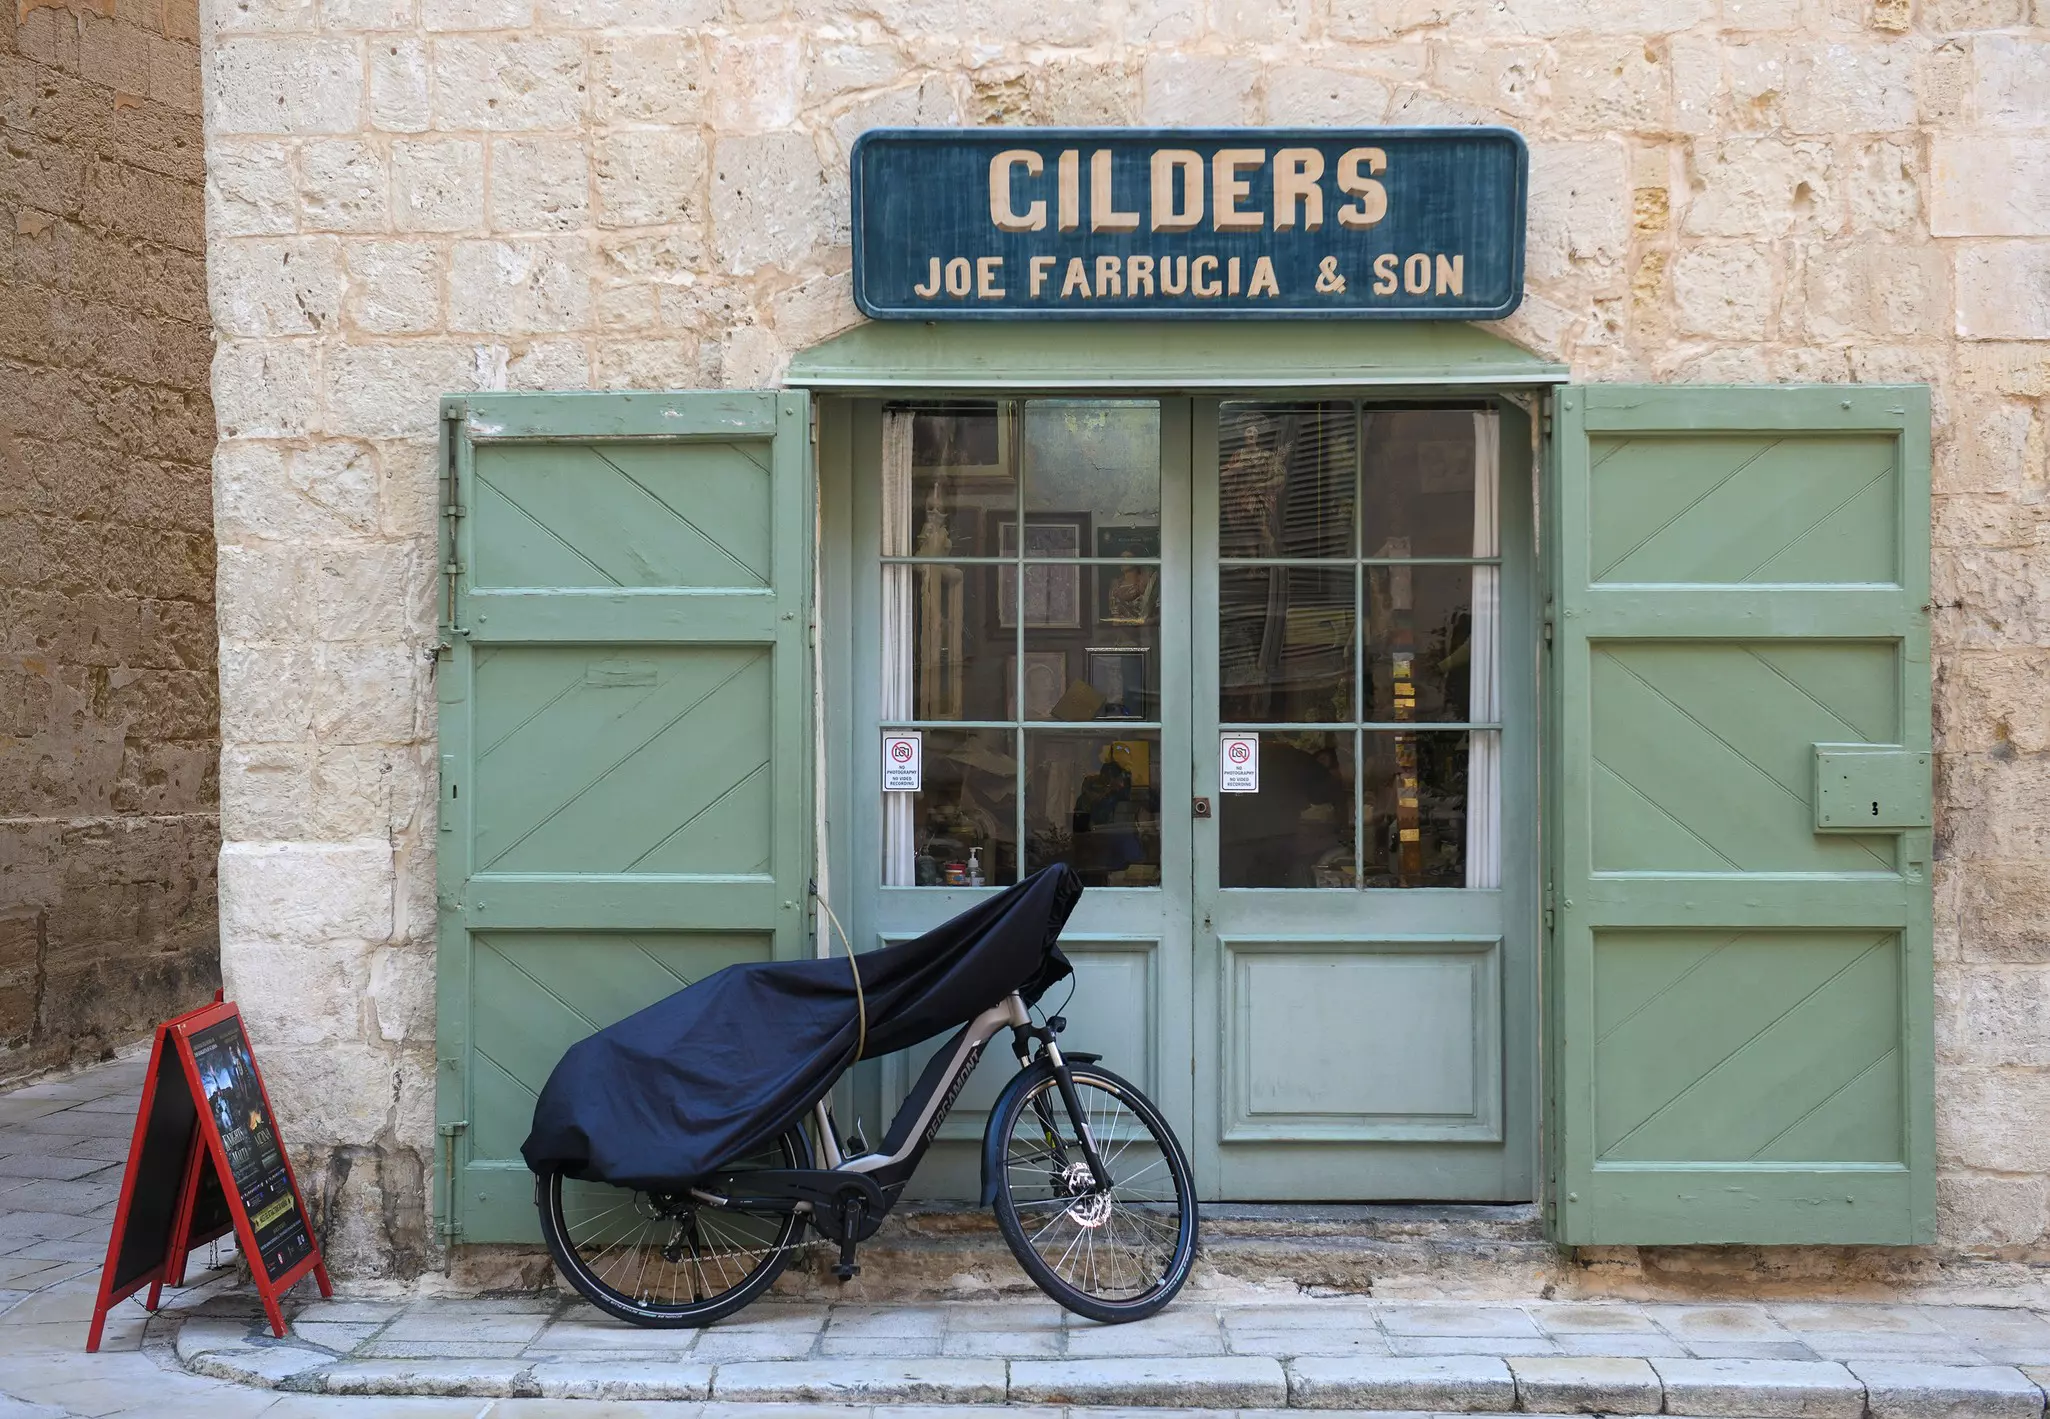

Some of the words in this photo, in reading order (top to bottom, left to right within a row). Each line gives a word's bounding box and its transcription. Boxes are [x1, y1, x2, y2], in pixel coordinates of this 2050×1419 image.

[914, 256, 1006, 299] JOE
[1315, 255, 1346, 294] &
[1373, 252, 1464, 297] SON
